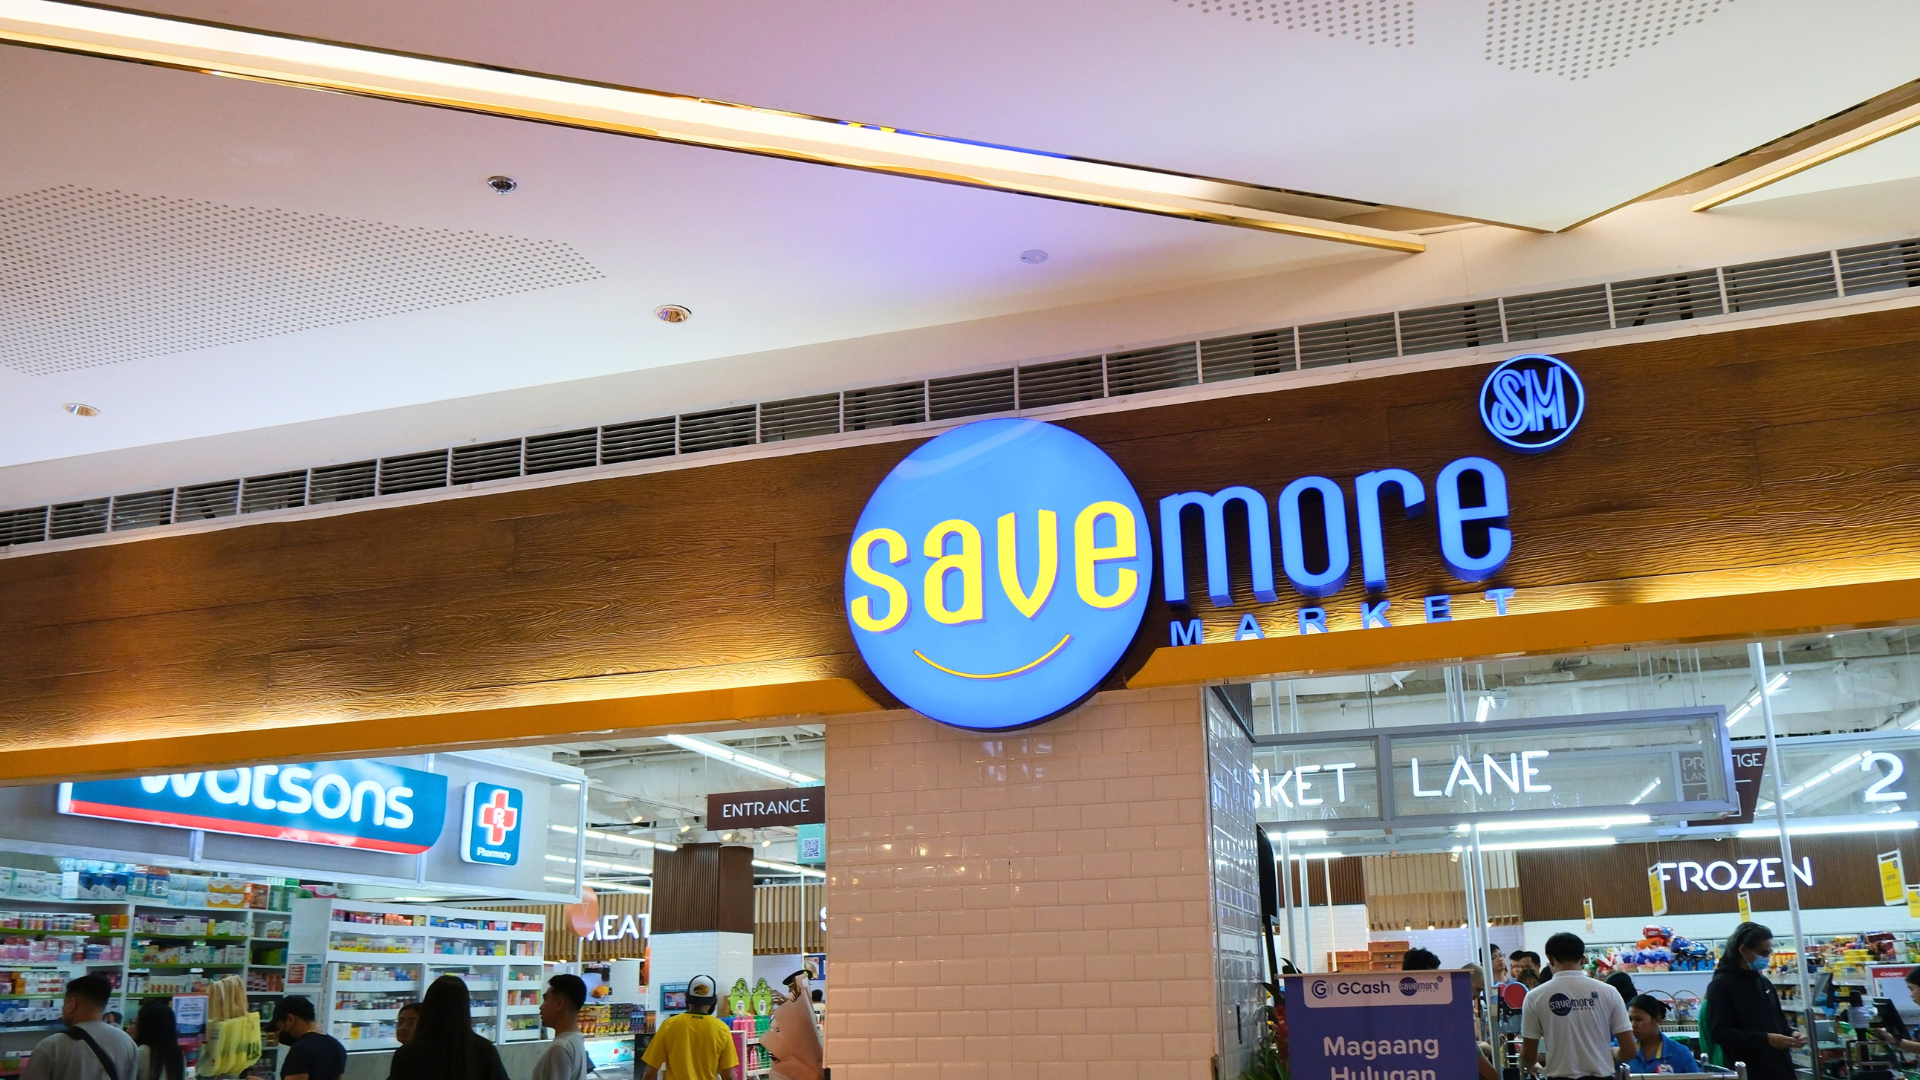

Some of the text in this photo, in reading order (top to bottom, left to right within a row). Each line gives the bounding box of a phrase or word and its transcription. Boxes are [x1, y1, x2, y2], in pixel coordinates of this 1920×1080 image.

[1491, 366, 1567, 436] SM
[1170, 588, 1515, 647] MARKET
[1411, 750, 1552, 797] LANE
[1861, 752, 1908, 802] 2
[722, 798, 810, 818] ENTRANCE
[477, 846, 512, 861] Pharmacy
[1660, 856, 1813, 892] FROZEN
[1337, 980, 1391, 996] GCash
[1323, 1035, 1439, 1061] Magaang
